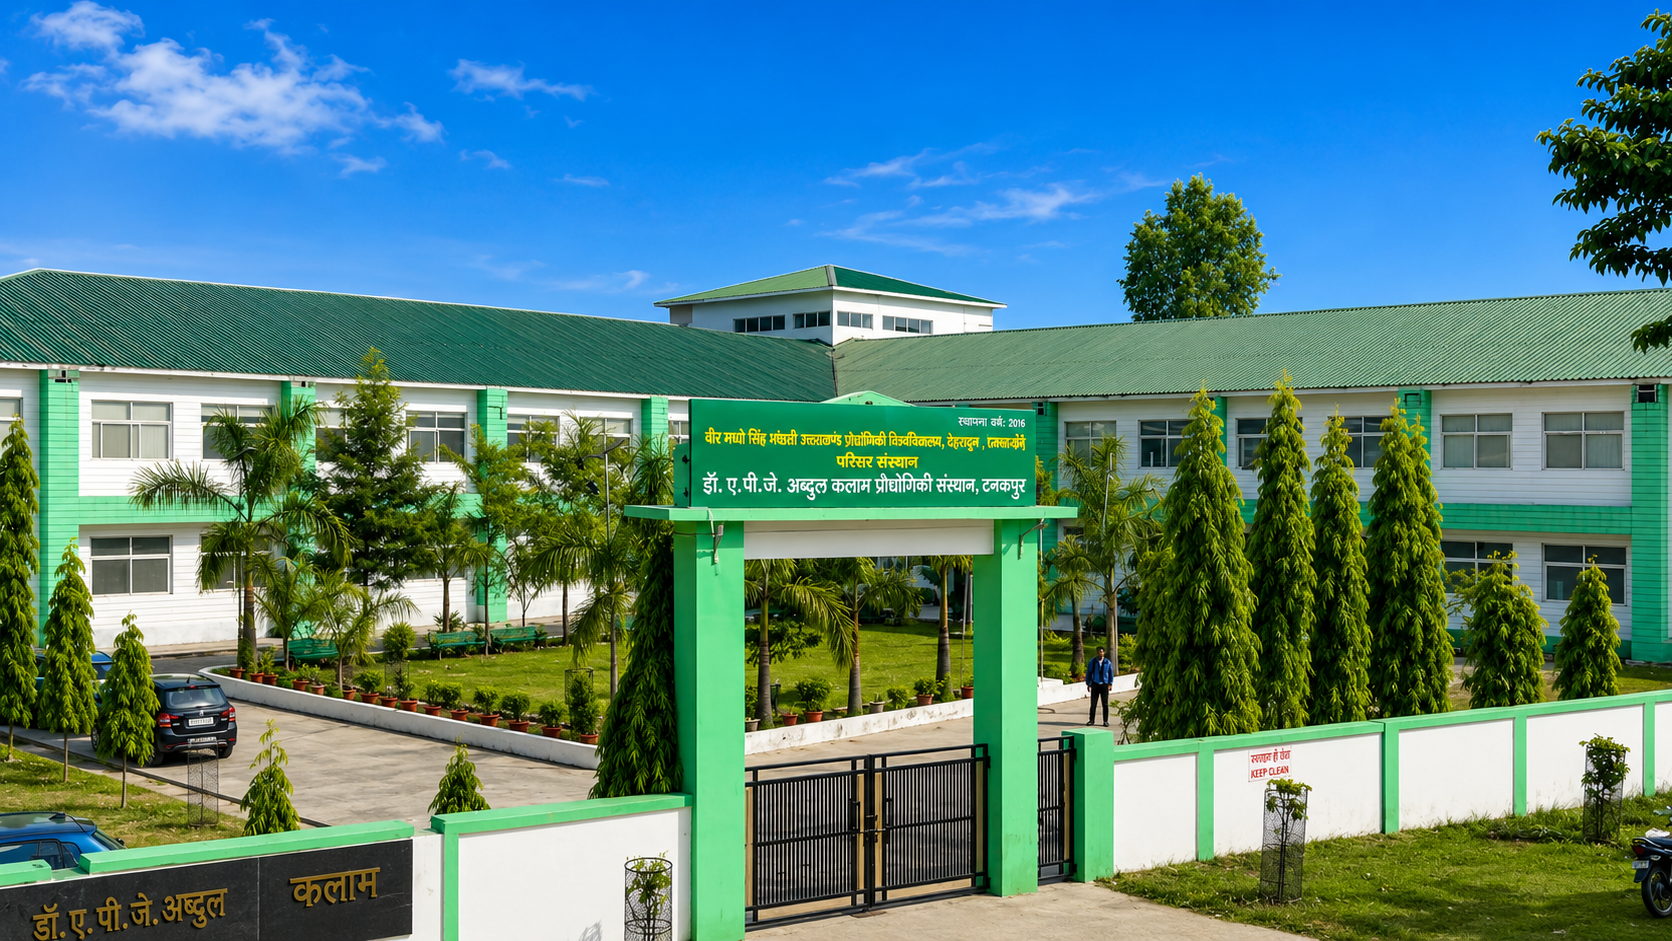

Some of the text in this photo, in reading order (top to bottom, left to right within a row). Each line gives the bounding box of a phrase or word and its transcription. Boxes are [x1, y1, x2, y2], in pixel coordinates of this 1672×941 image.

[1009, 419, 1025, 427] 2016
[705, 427, 722, 444] वीर
[748, 428, 767, 446] सिंह
[836, 452, 873, 468] परिसर
[703, 472, 722, 494] डॉ.
[787, 479, 828, 500] अब्दुल
[831, 479, 872, 493] कलाम
[936, 474, 979, 494] संस्थान,
[982, 479, 1026, 499] टनकपुर
[1251, 765, 1289, 779] KEEP CLEAN
[289, 867, 381, 906] कलाम
[32, 902, 66, 941] डॉ.
